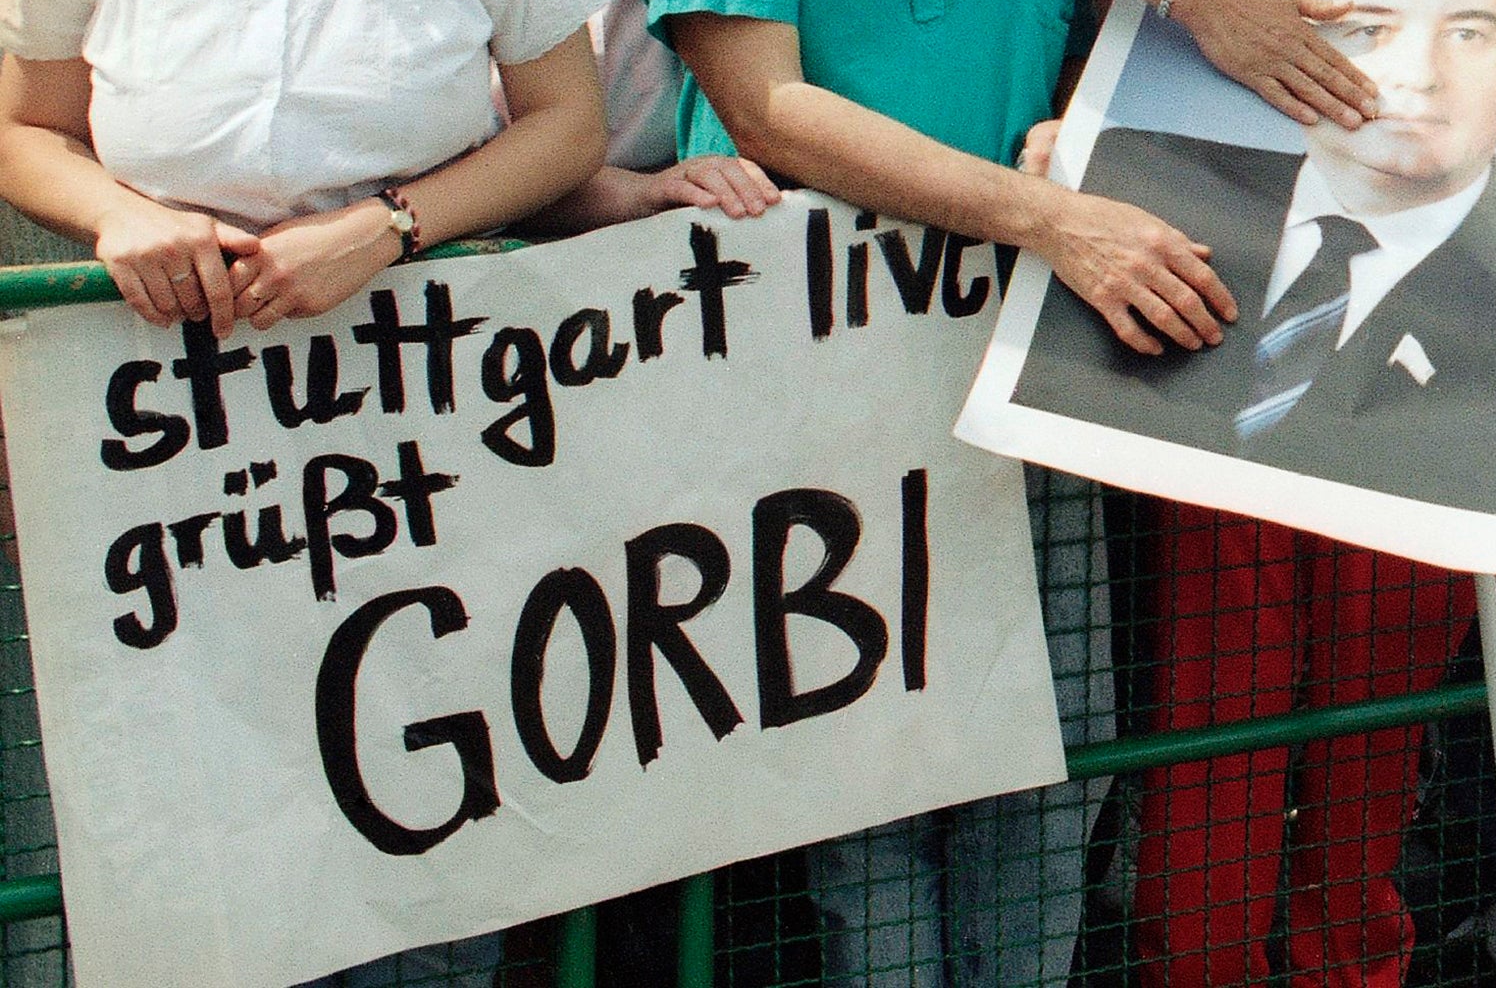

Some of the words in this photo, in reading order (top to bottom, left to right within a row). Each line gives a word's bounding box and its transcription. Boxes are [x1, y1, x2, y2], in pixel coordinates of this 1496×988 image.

[100, 221, 761, 471] stuttgart
[104, 440, 460, 650] grüßt
[315, 468, 929, 856] GORBI
